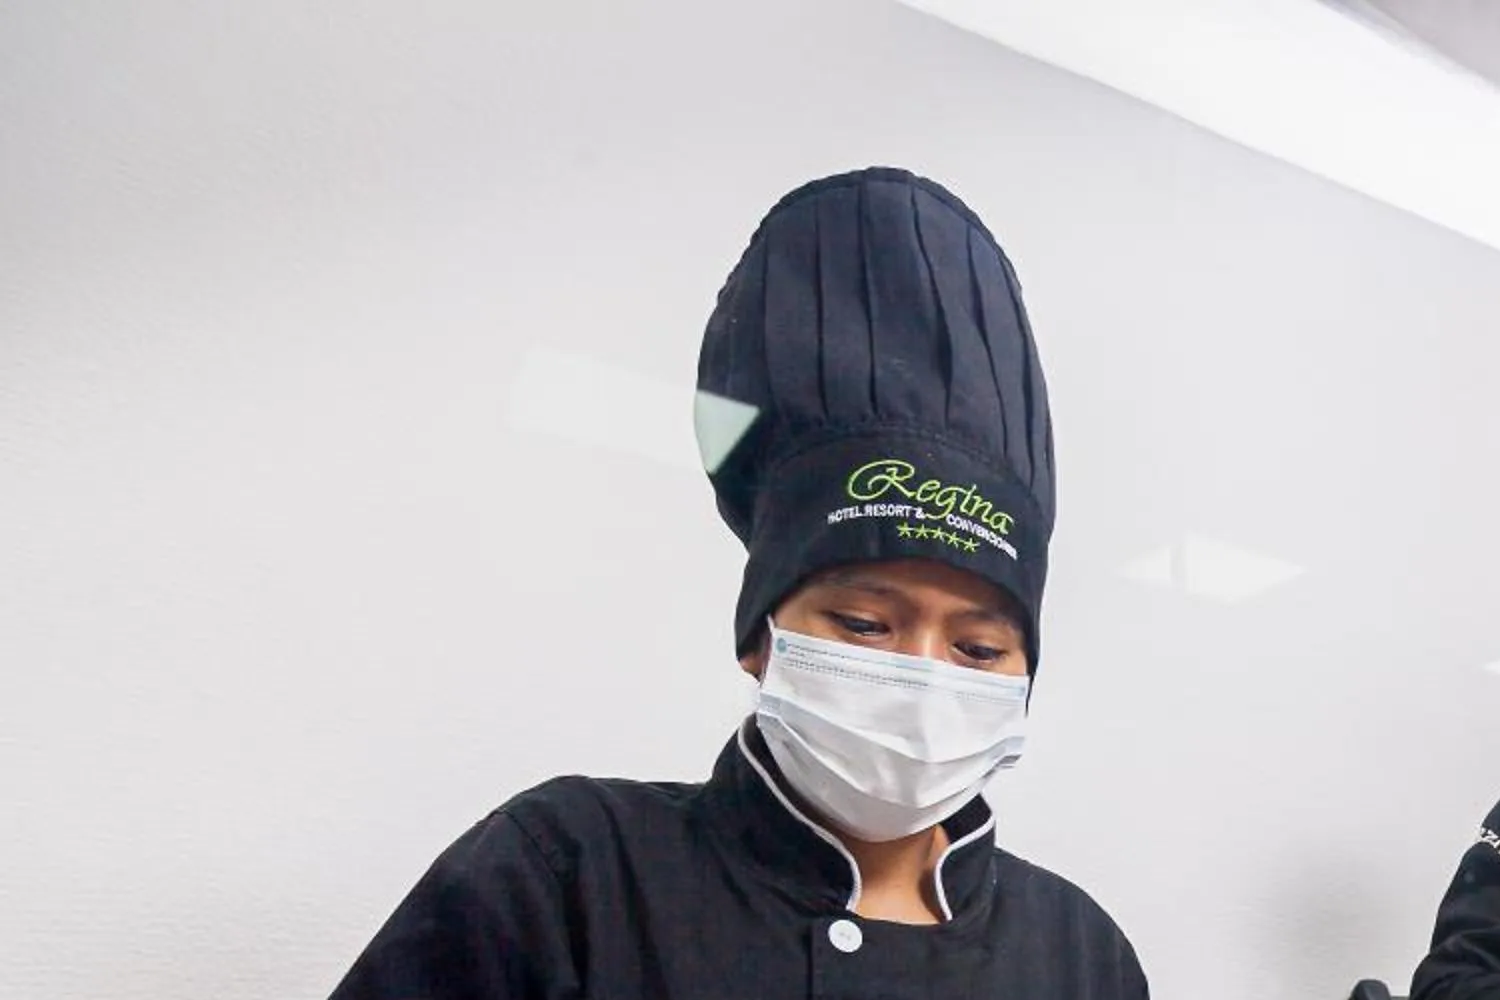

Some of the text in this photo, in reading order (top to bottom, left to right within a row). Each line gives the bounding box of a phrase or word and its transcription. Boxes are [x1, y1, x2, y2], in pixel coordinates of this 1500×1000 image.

[827, 505, 863, 525] HOTEL
[863, 503, 912, 518] RESORT
[848, 459, 1015, 535] Regina
